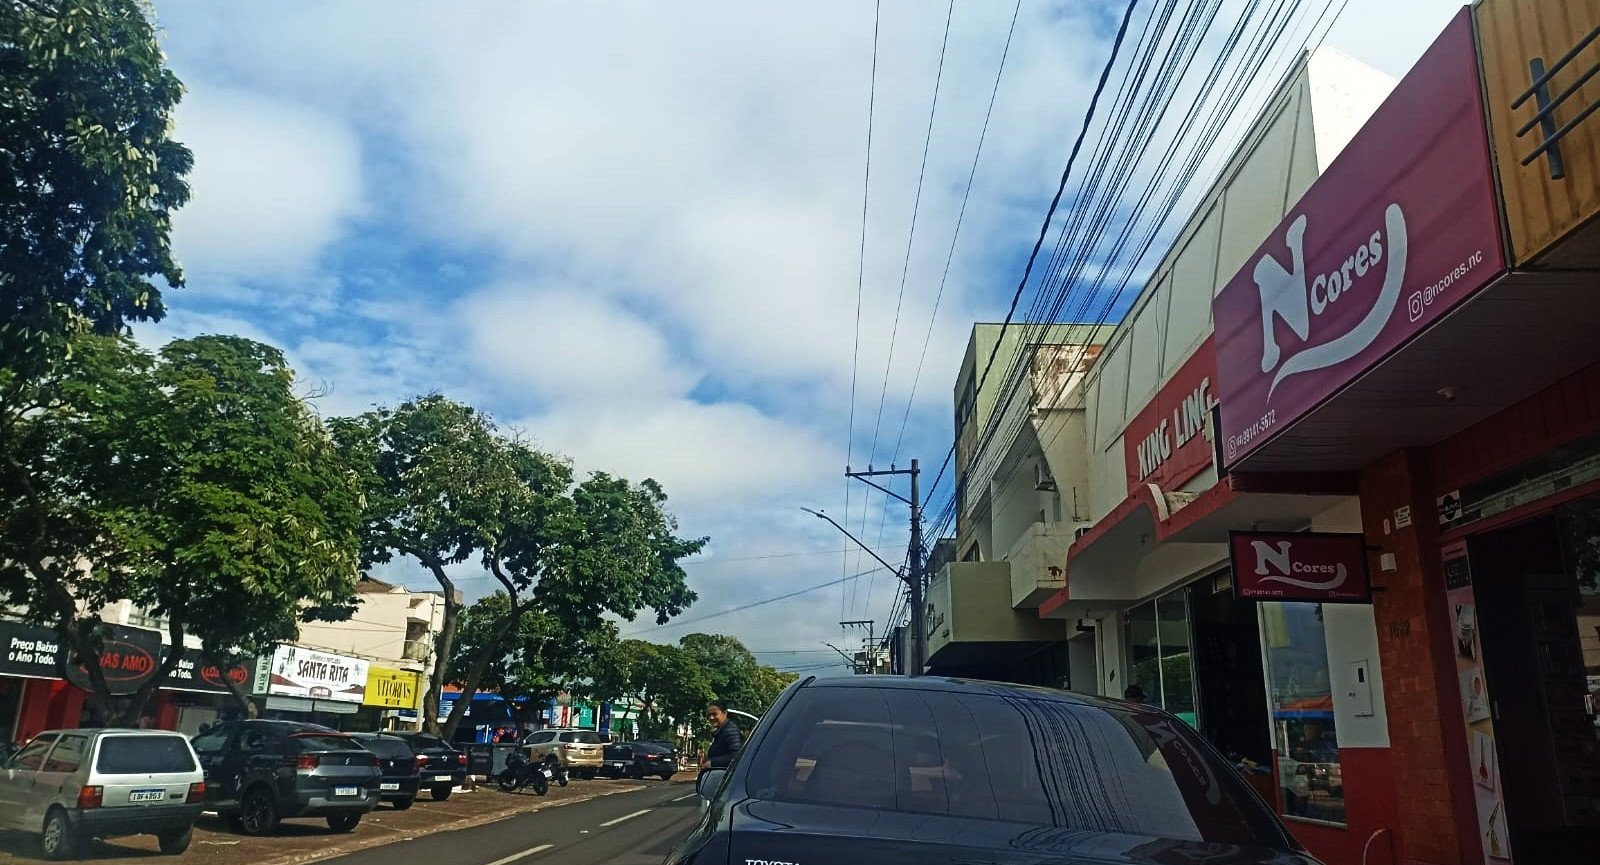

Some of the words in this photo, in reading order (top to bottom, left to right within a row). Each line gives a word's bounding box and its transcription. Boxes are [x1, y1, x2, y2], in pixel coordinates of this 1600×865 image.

[1422, 250, 1482, 306] @ncores.nc
[1254, 213, 1308, 374] N
[1137, 418, 1170, 482] KING
[1250, 540, 1292, 576] N
[1292, 561, 1336, 574] Cores
[8, 652, 15, 661] o
[15, 651, 33, 663] Ano
[34, 653, 56, 665] Todo.
[10, 637, 34, 651] Preço
[35, 640, 59, 654] Baixo
[120, 655, 148, 672] AMO
[297, 659, 328, 680] SANTA
[328, 663, 349, 683] RITA
